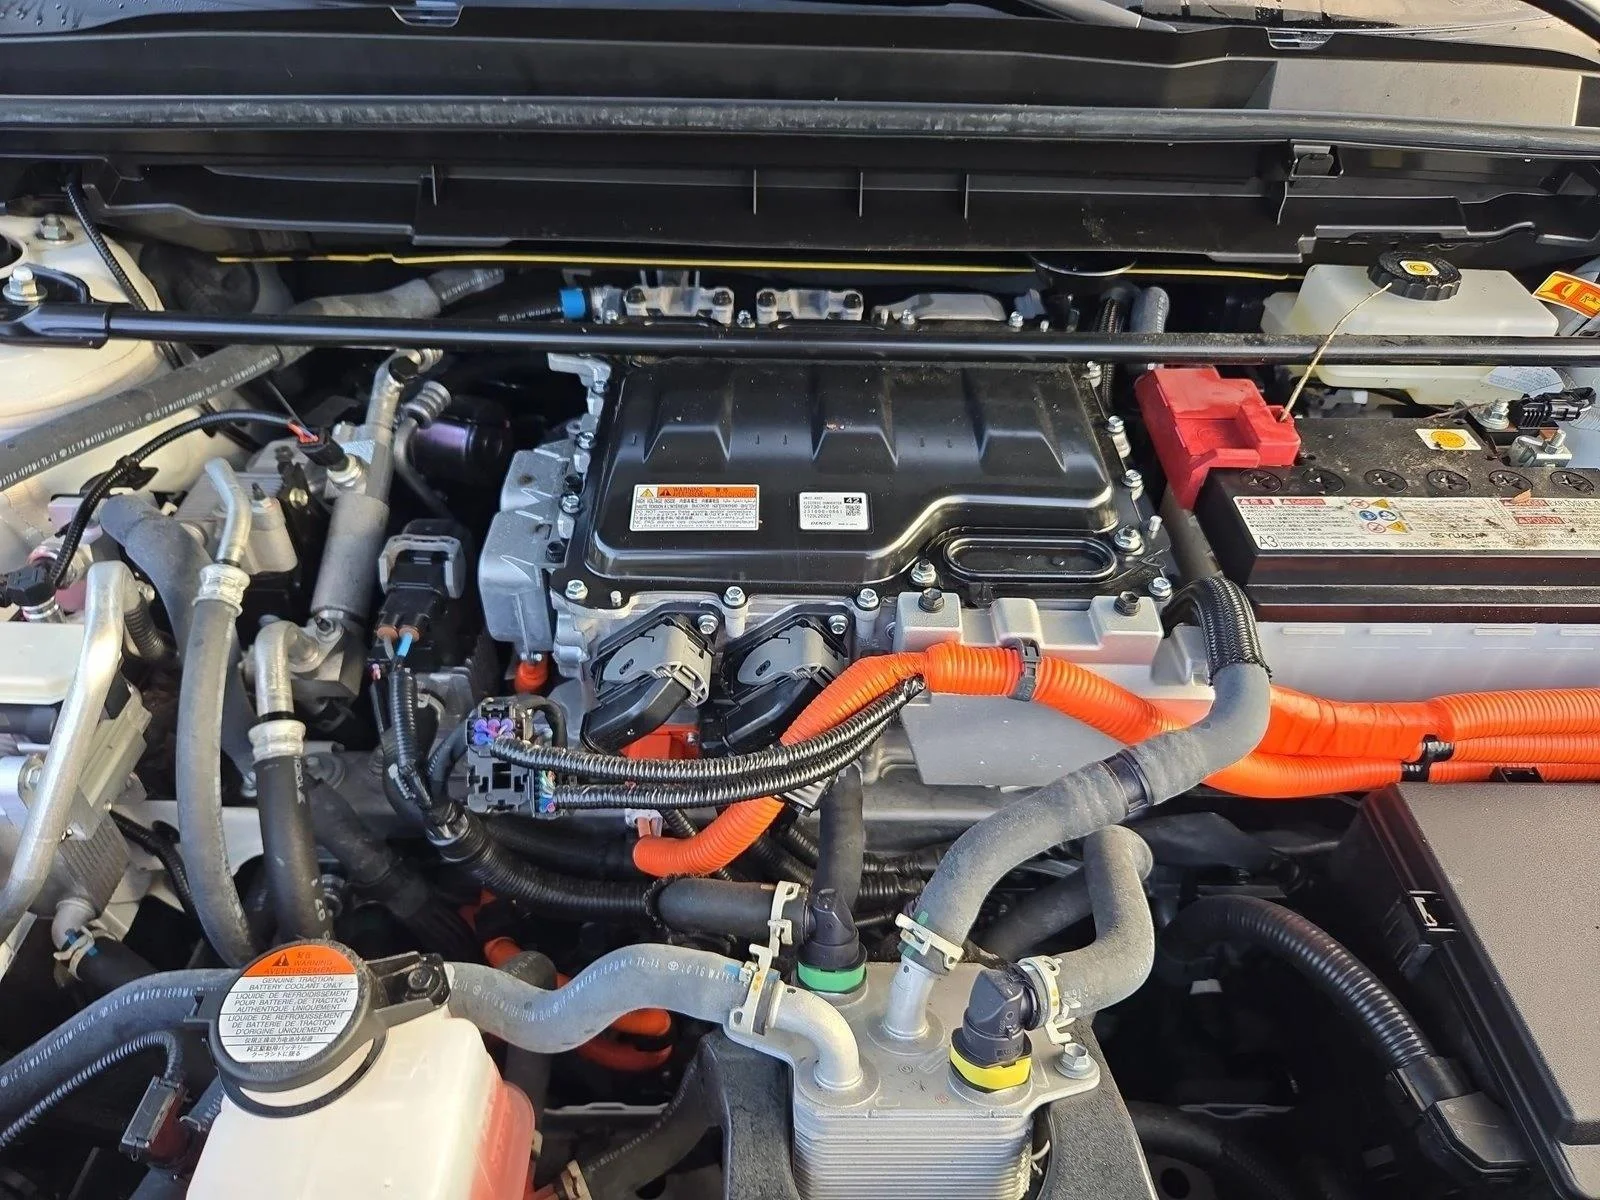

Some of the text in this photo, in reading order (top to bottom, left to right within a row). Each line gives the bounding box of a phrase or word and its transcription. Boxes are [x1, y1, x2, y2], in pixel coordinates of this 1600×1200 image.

[1259, 535, 1278, 548] A3
[575, 971, 597, 993] WATER
[708, 968, 736, 984] WATER
[133, 987, 161, 1003] WATER
[275, 1012, 344, 1020] REFROIDISSEMENT
[29, 1045, 53, 1068] WATER
